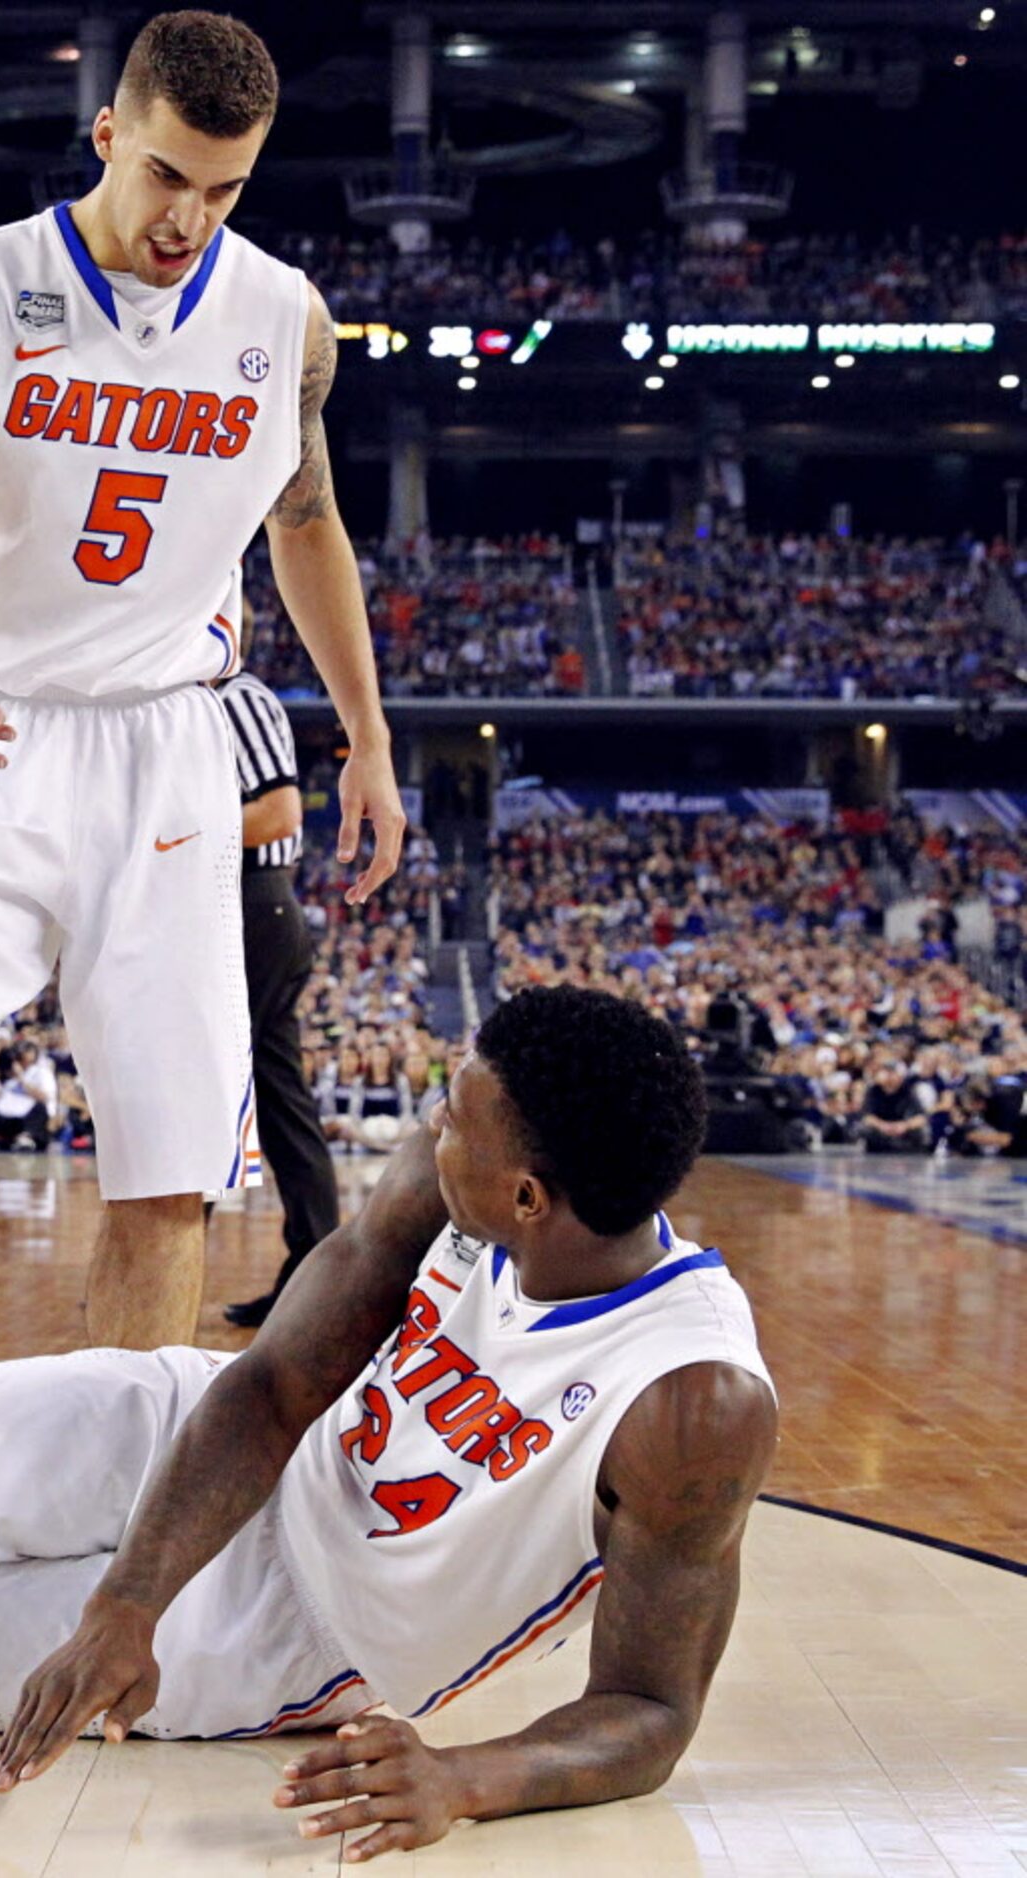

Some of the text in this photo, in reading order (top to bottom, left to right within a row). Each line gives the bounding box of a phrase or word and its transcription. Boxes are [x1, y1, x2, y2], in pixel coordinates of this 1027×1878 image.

[240, 350, 268, 380] SEC
[3, 372, 259, 459] GATORS
[72, 468, 169, 586] 5
